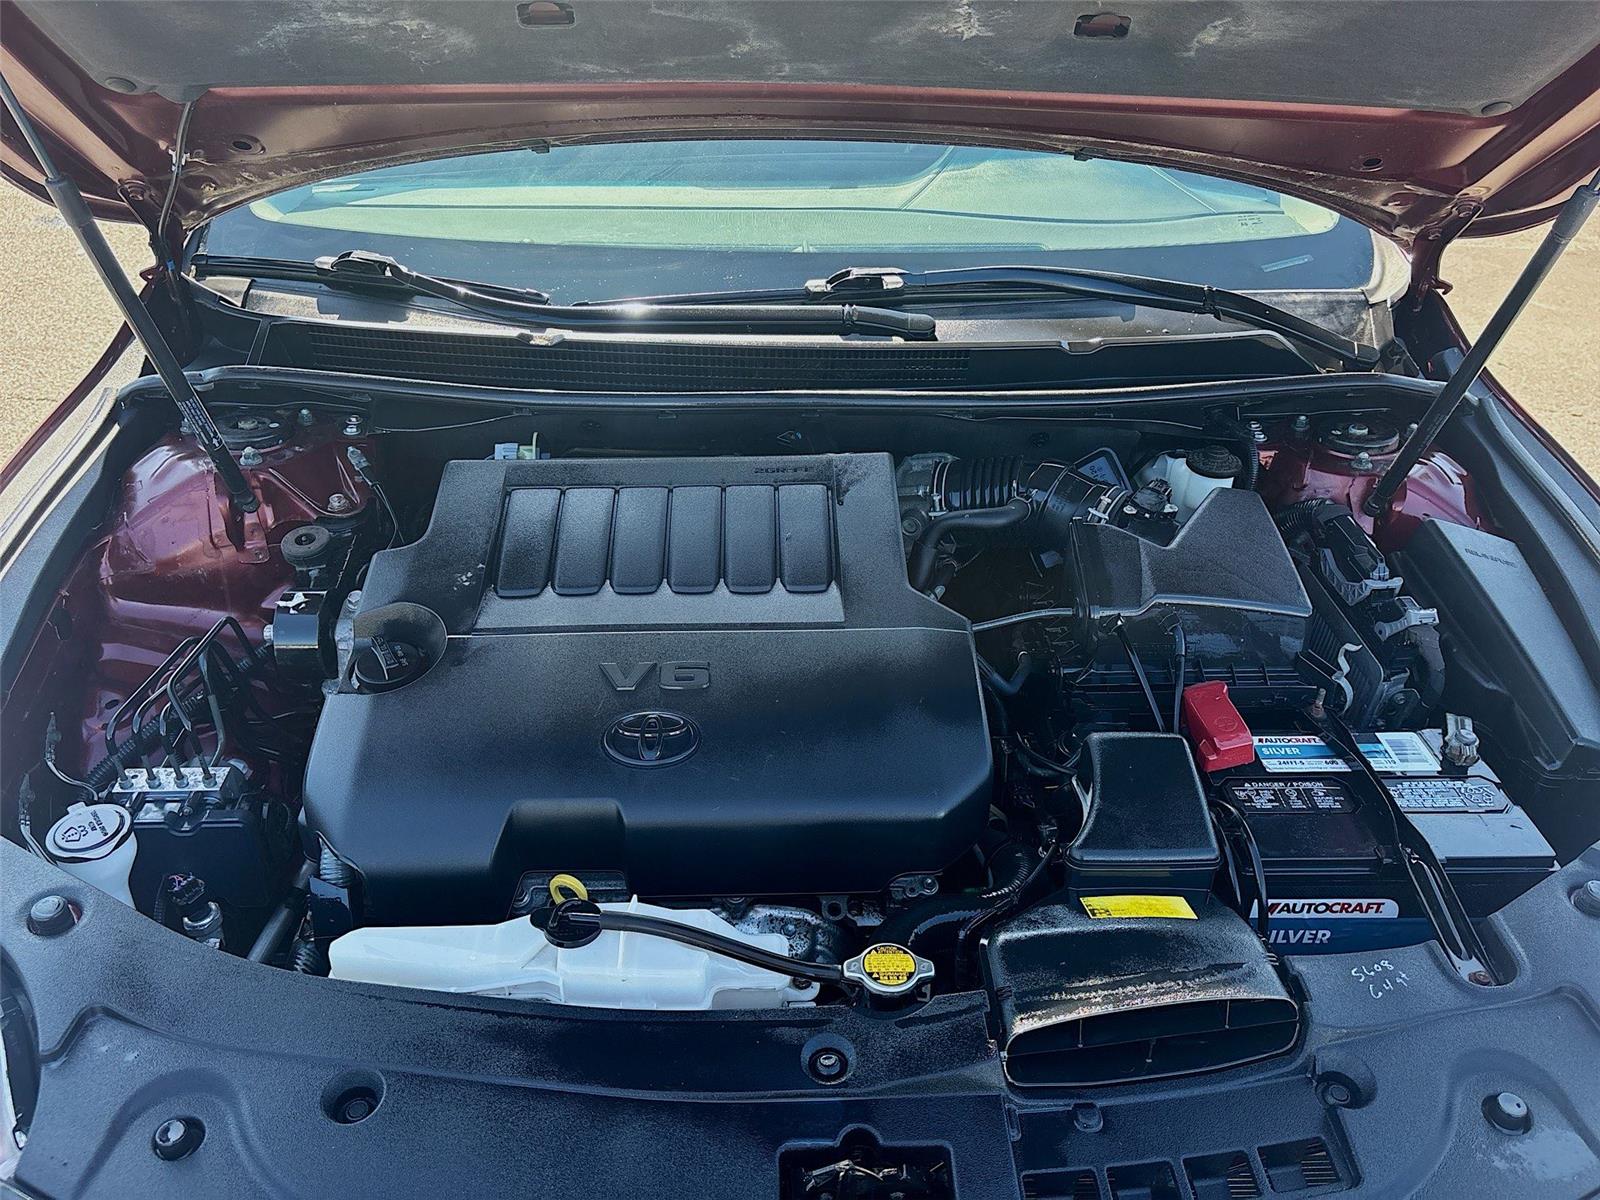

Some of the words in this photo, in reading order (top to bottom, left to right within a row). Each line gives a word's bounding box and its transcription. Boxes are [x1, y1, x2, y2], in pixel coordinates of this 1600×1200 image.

[598, 660, 711, 691] V6
[1262, 747, 1302, 756] SILVER
[1276, 902, 1386, 914] AUTOCRAFT
[1268, 929, 1332, 944] ILVER
